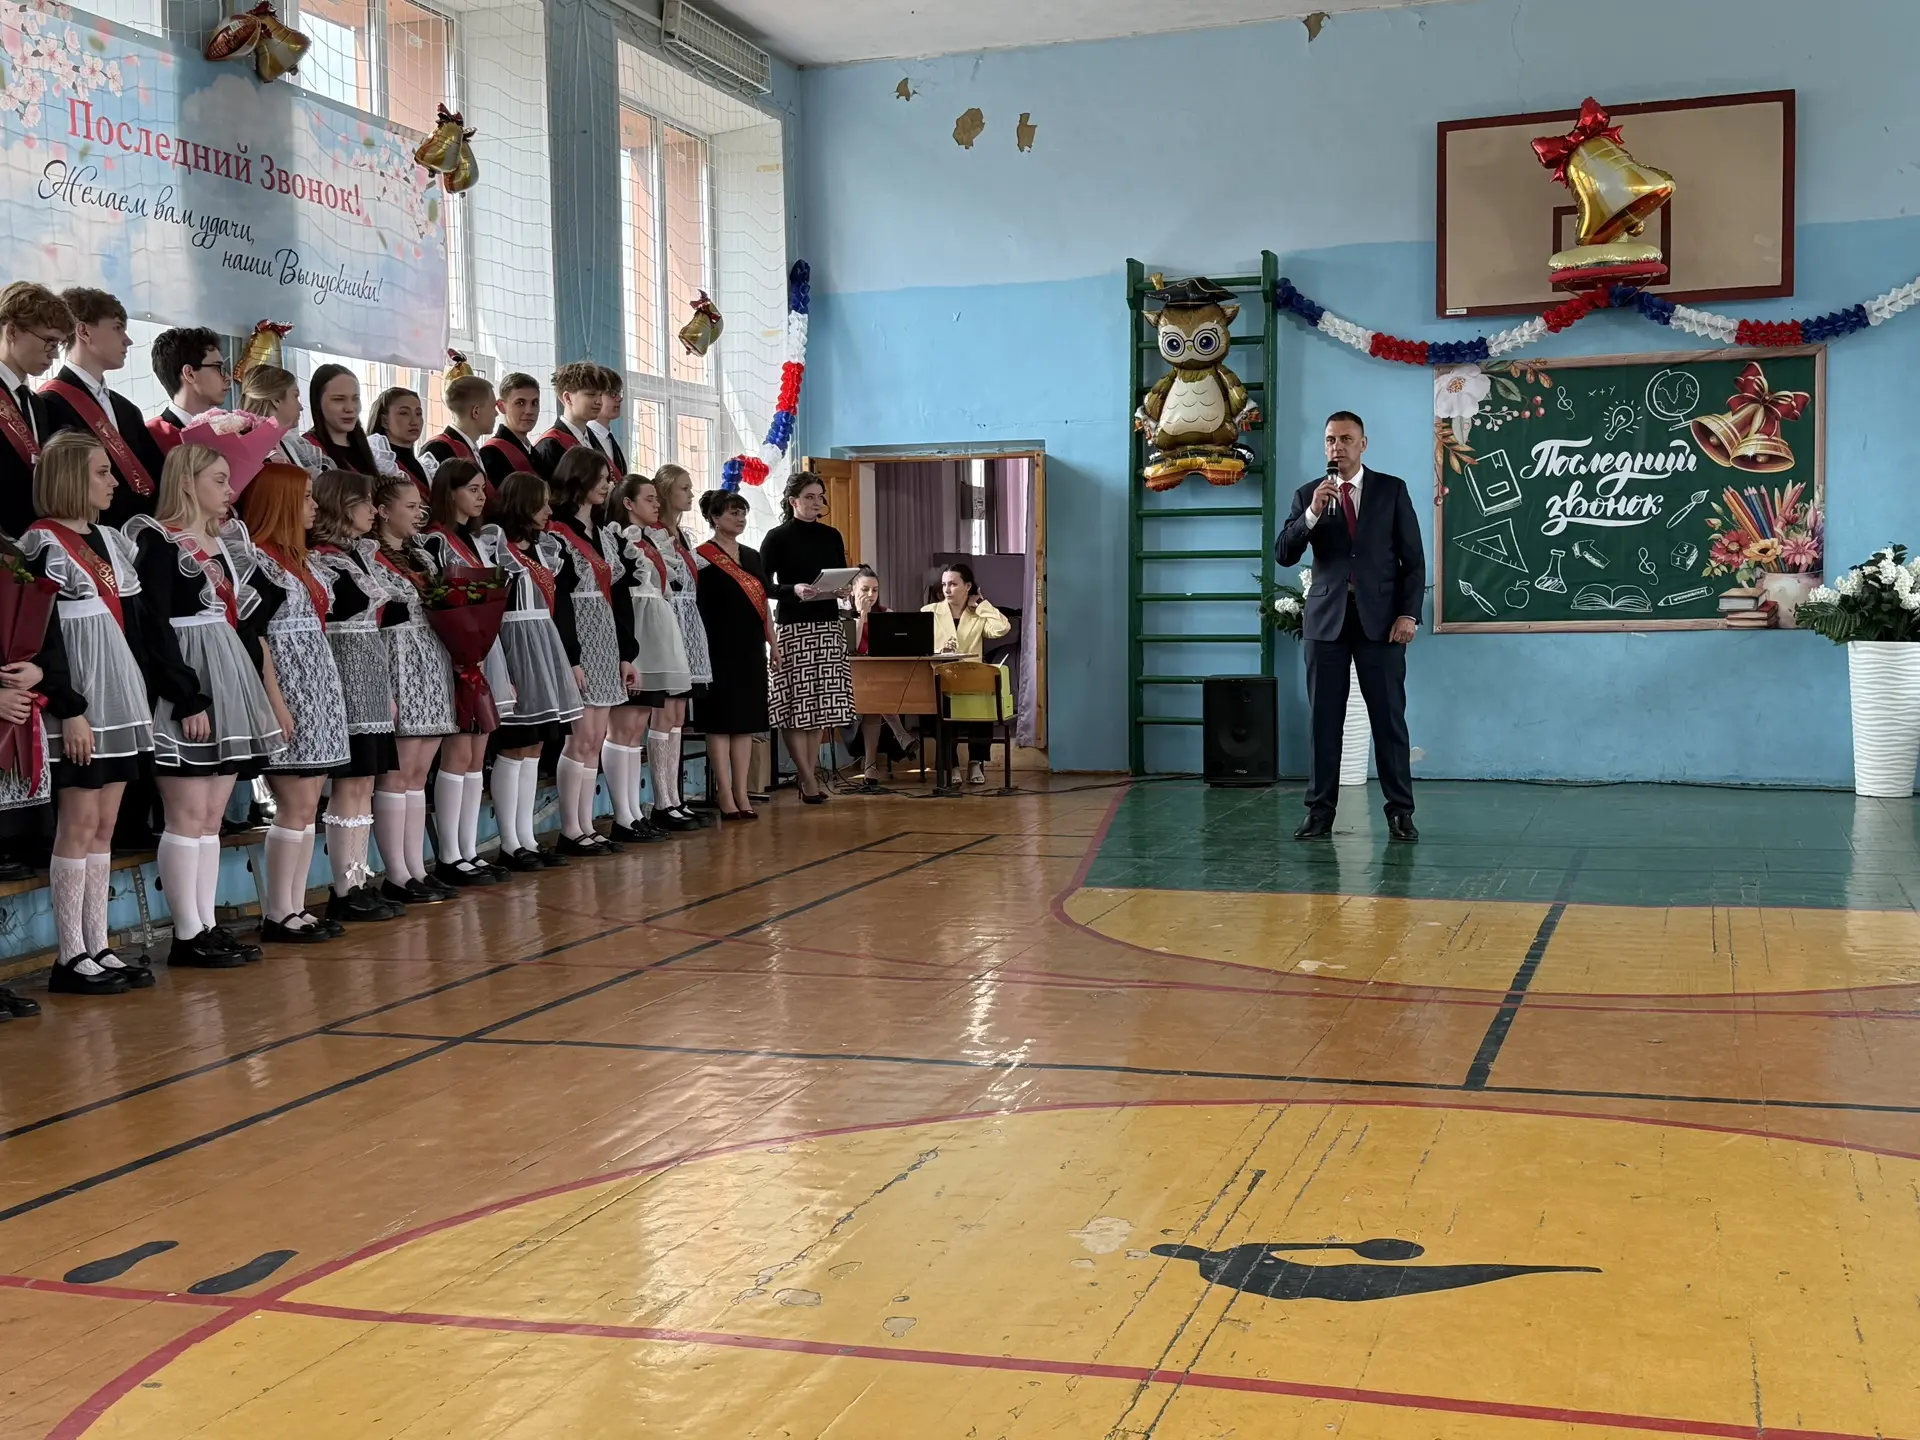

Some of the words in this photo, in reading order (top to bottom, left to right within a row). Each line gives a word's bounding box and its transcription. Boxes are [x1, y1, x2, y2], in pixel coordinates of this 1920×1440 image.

[66, 96, 253, 185] Последний
[260, 154, 361, 217] Звонок!
[37, 159, 149, 218] Желаем
[153, 185, 196, 228] вам
[191, 214, 255, 249] удачи,
[222, 250, 274, 278] наши
[274, 248, 384, 305] Выпускники!
[1519, 435, 1698, 498] Последний
[1540, 480, 1665, 537] звонок
[1678, 543, 1689, 554] 3
